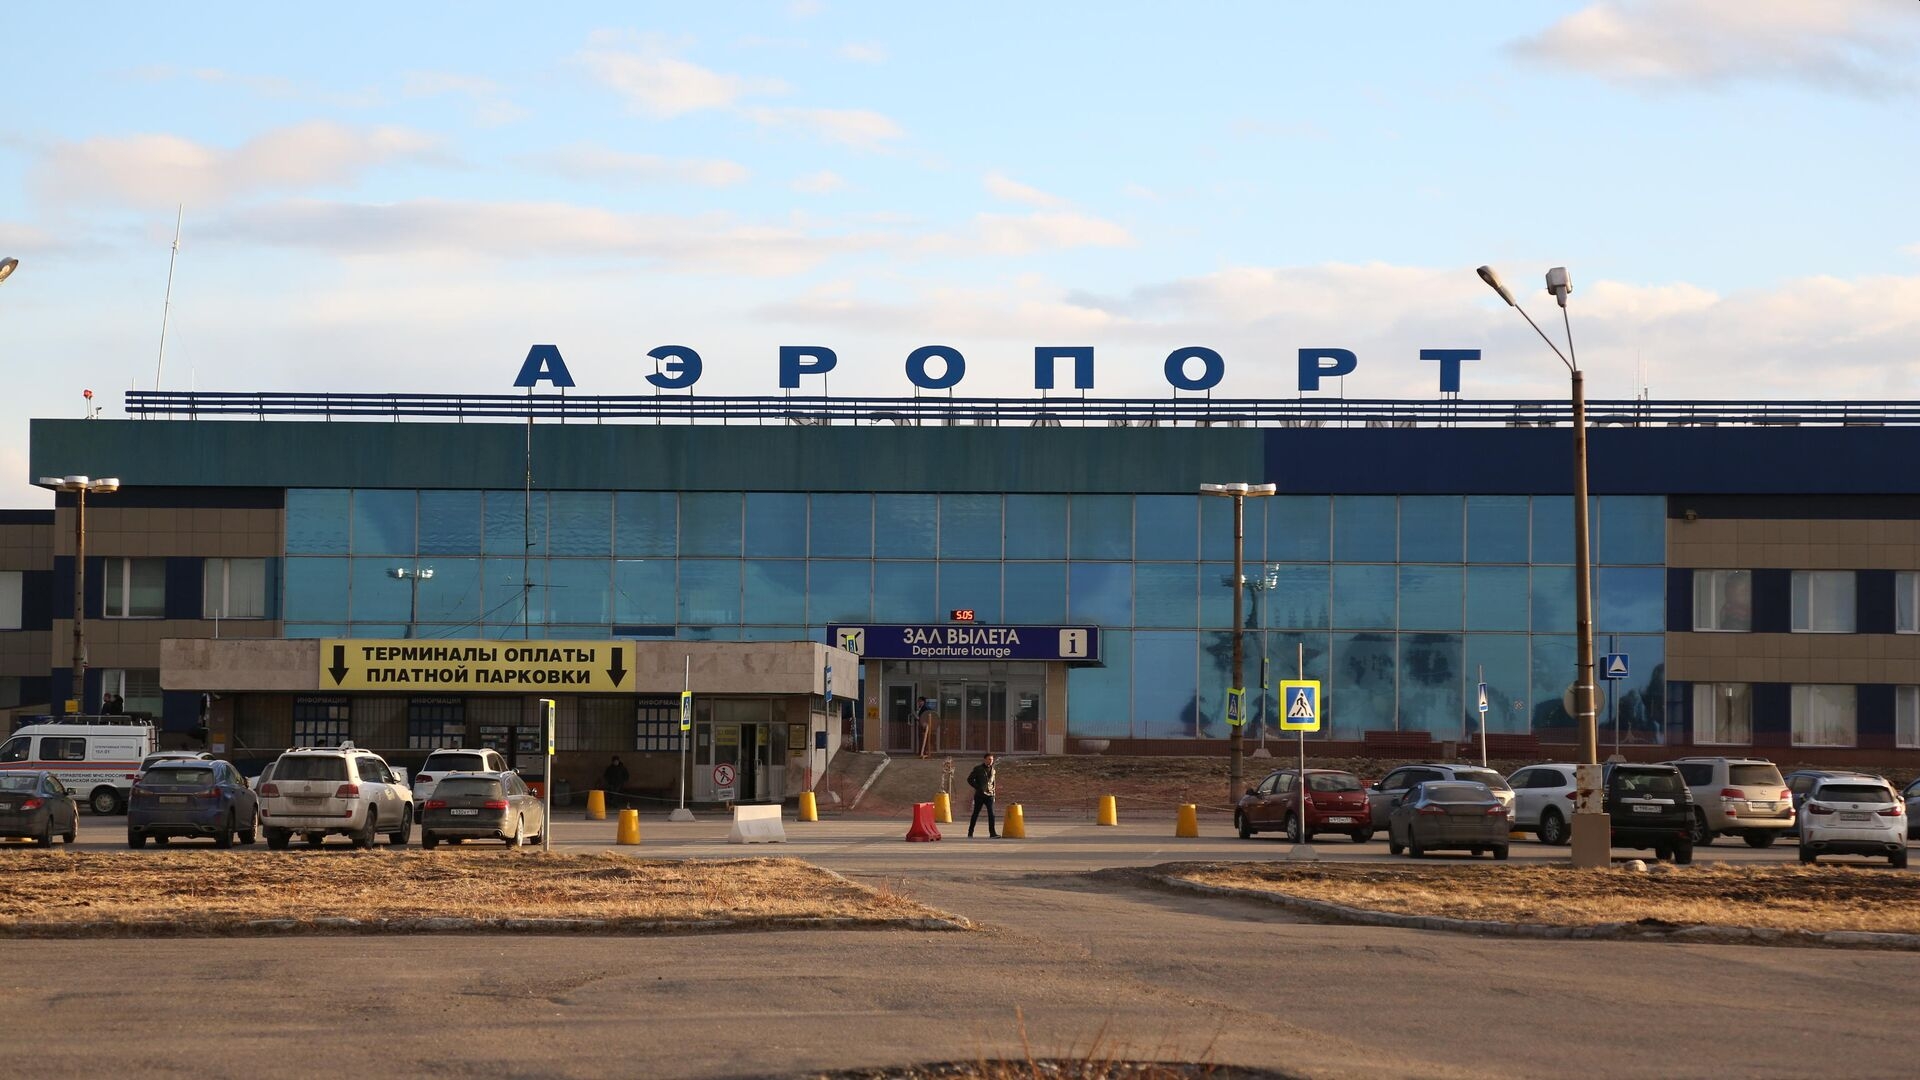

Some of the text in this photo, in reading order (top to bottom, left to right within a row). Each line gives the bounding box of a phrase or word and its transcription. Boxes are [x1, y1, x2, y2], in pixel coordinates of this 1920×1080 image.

[514, 344, 1481, 389] АЭРОПОРТ
[903, 628, 1020, 645] ЗАЛ ВЫЛЕТА
[362, 646, 595, 663] ТЕРМИНАЛЫ ОПЛАТЫ
[912, 645, 1011, 658] Departure lounge
[366, 665, 591, 684] ПЛАТНОЙ ПАРКОВКИ
